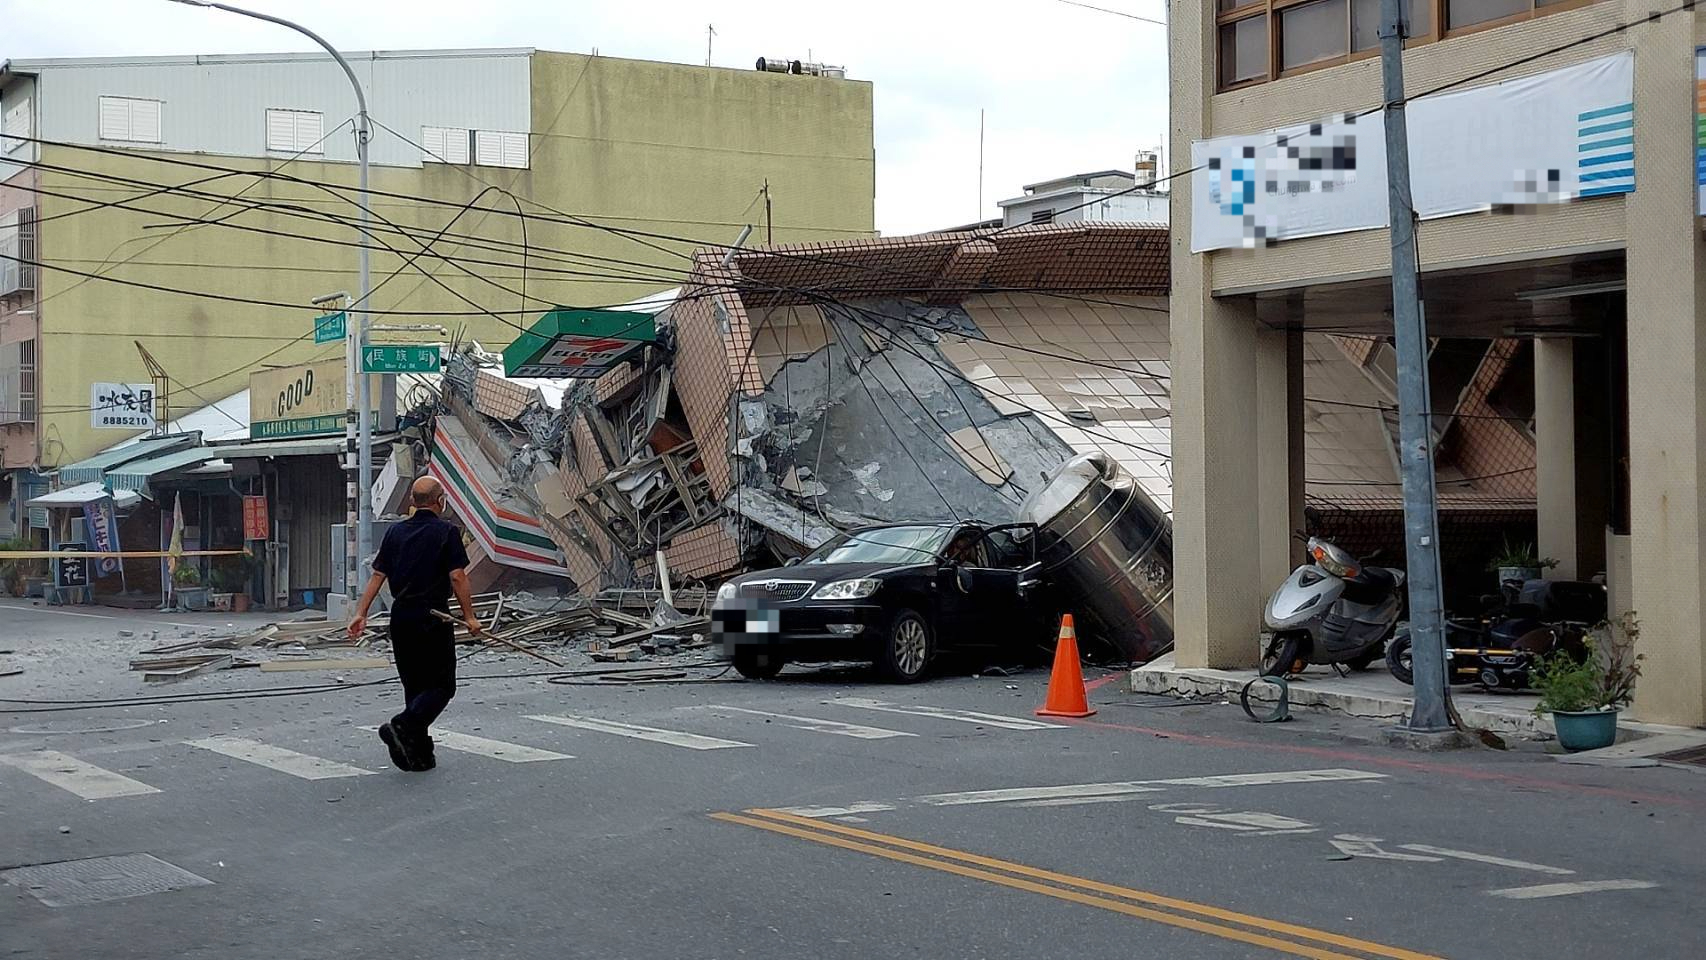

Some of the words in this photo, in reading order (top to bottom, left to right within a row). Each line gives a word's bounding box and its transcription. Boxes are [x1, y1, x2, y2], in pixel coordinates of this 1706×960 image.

[373, 348, 429, 362] 民族街
[278, 370, 313, 417] GOOD
[103, 416, 148, 426] 8885210
